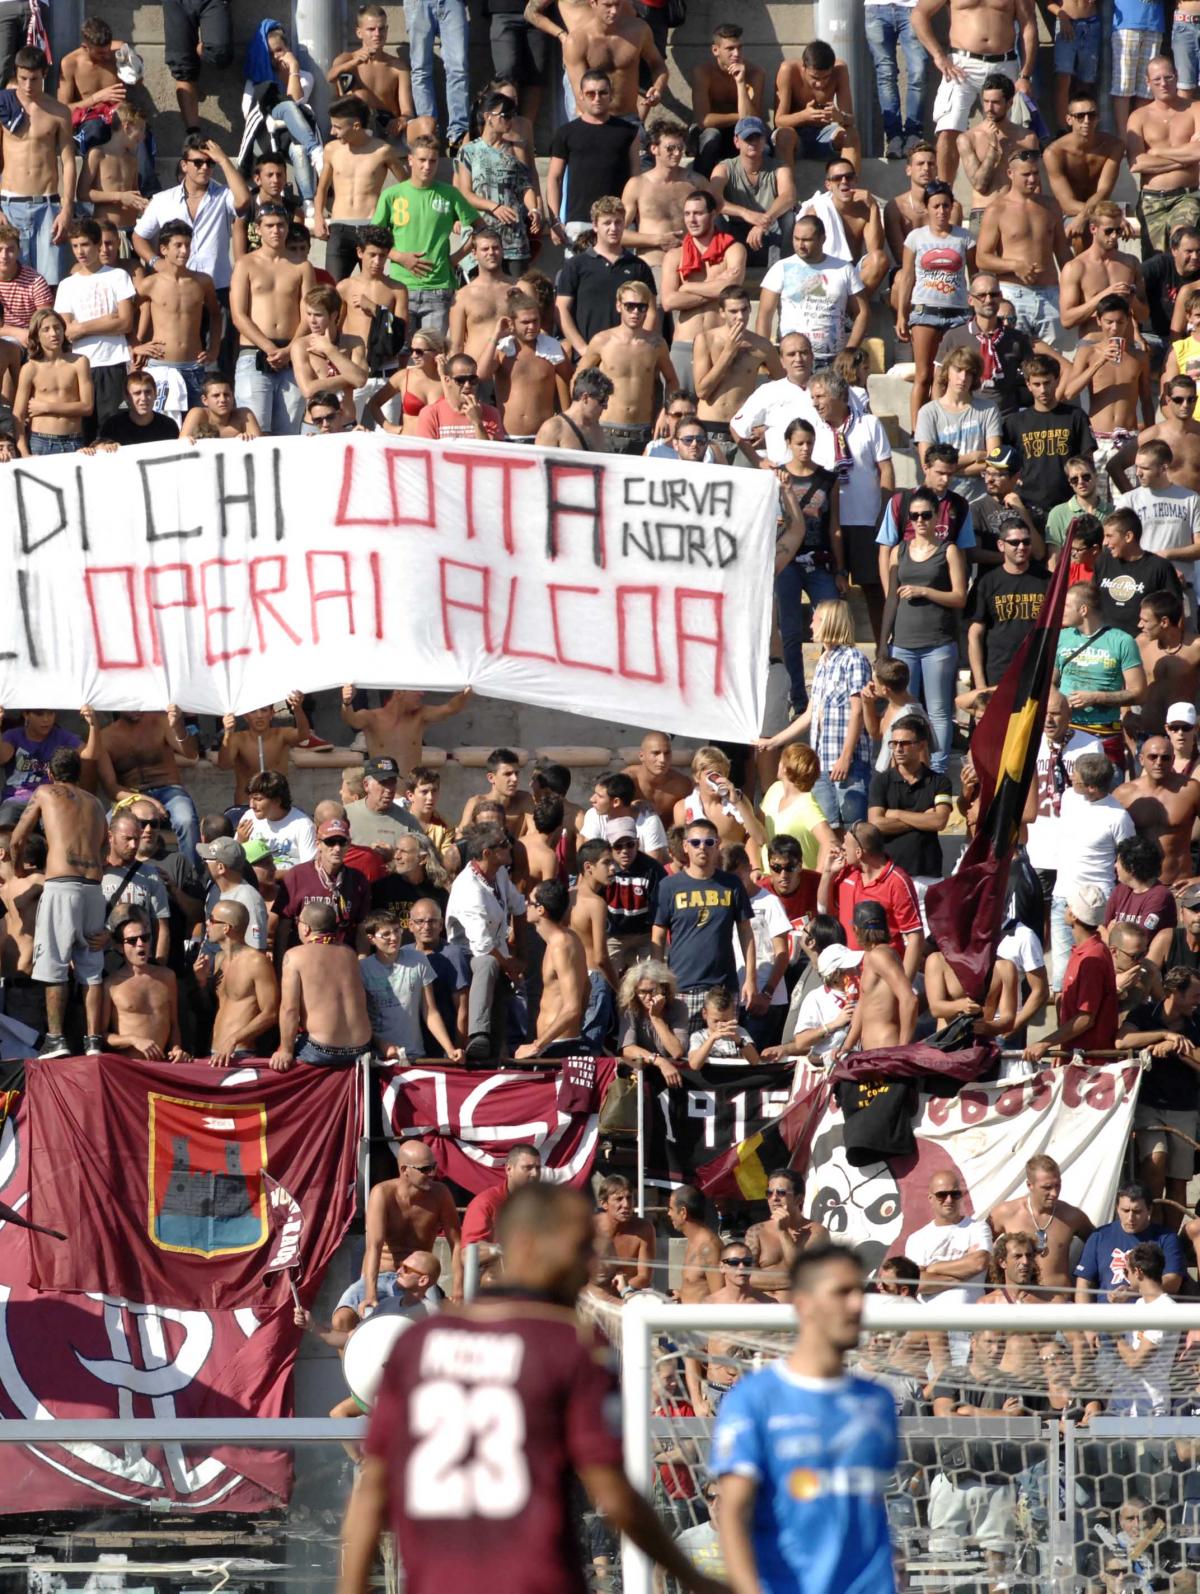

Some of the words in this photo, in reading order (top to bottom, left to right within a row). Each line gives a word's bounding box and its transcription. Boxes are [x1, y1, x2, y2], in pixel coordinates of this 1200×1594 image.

[393, 197, 410, 226] 8
[1022, 428, 1071, 442] LIVORNO
[1023, 436, 1069, 460] 1915
[14, 464, 89, 555] DI
[137, 446, 286, 543] CHI
[334, 444, 607, 568] LOTTA
[622, 475, 734, 518] CURVA
[1153, 502, 1188, 520] THOMAS
[621, 519, 738, 568] NORD
[83, 550, 384, 671] OPERAI
[438, 557, 726, 698] ALCOA
[675, 889, 732, 910] CABJ
[405, 1378, 532, 1518] 23
